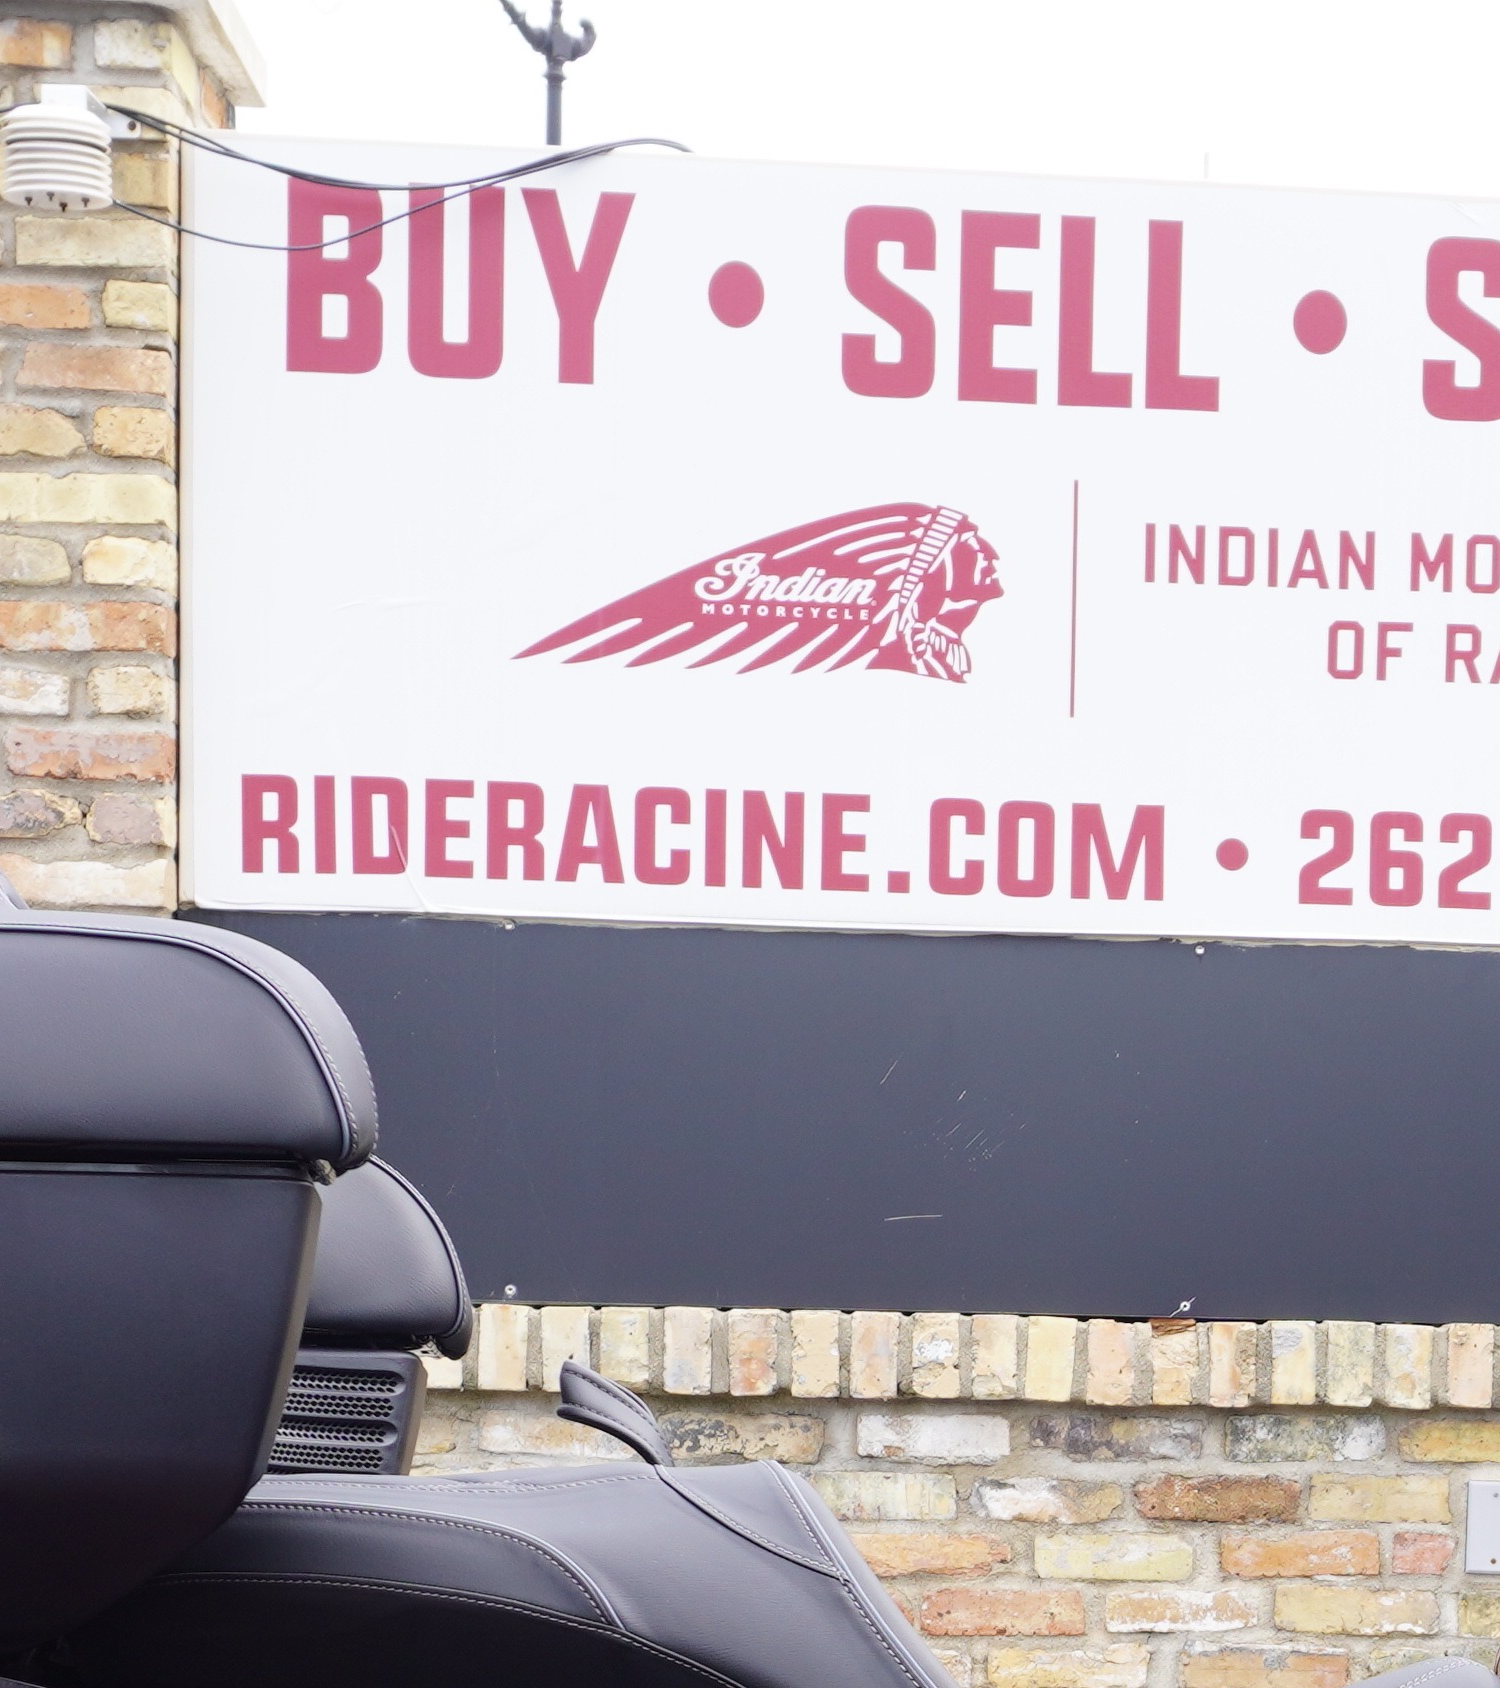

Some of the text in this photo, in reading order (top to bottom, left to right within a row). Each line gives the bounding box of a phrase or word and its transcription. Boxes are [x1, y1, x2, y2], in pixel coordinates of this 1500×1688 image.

[286, 176, 636, 385] BUY
[843, 207, 1218, 411] SELL
[694, 552, 877, 605] Indian
[1145, 525, 1375, 589] INDIAN
[702, 603, 870, 620] MOTORCYCLE
[1327, 622, 1412, 680] OF
[241, 774, 1164, 901] RIDERACINE.COM
